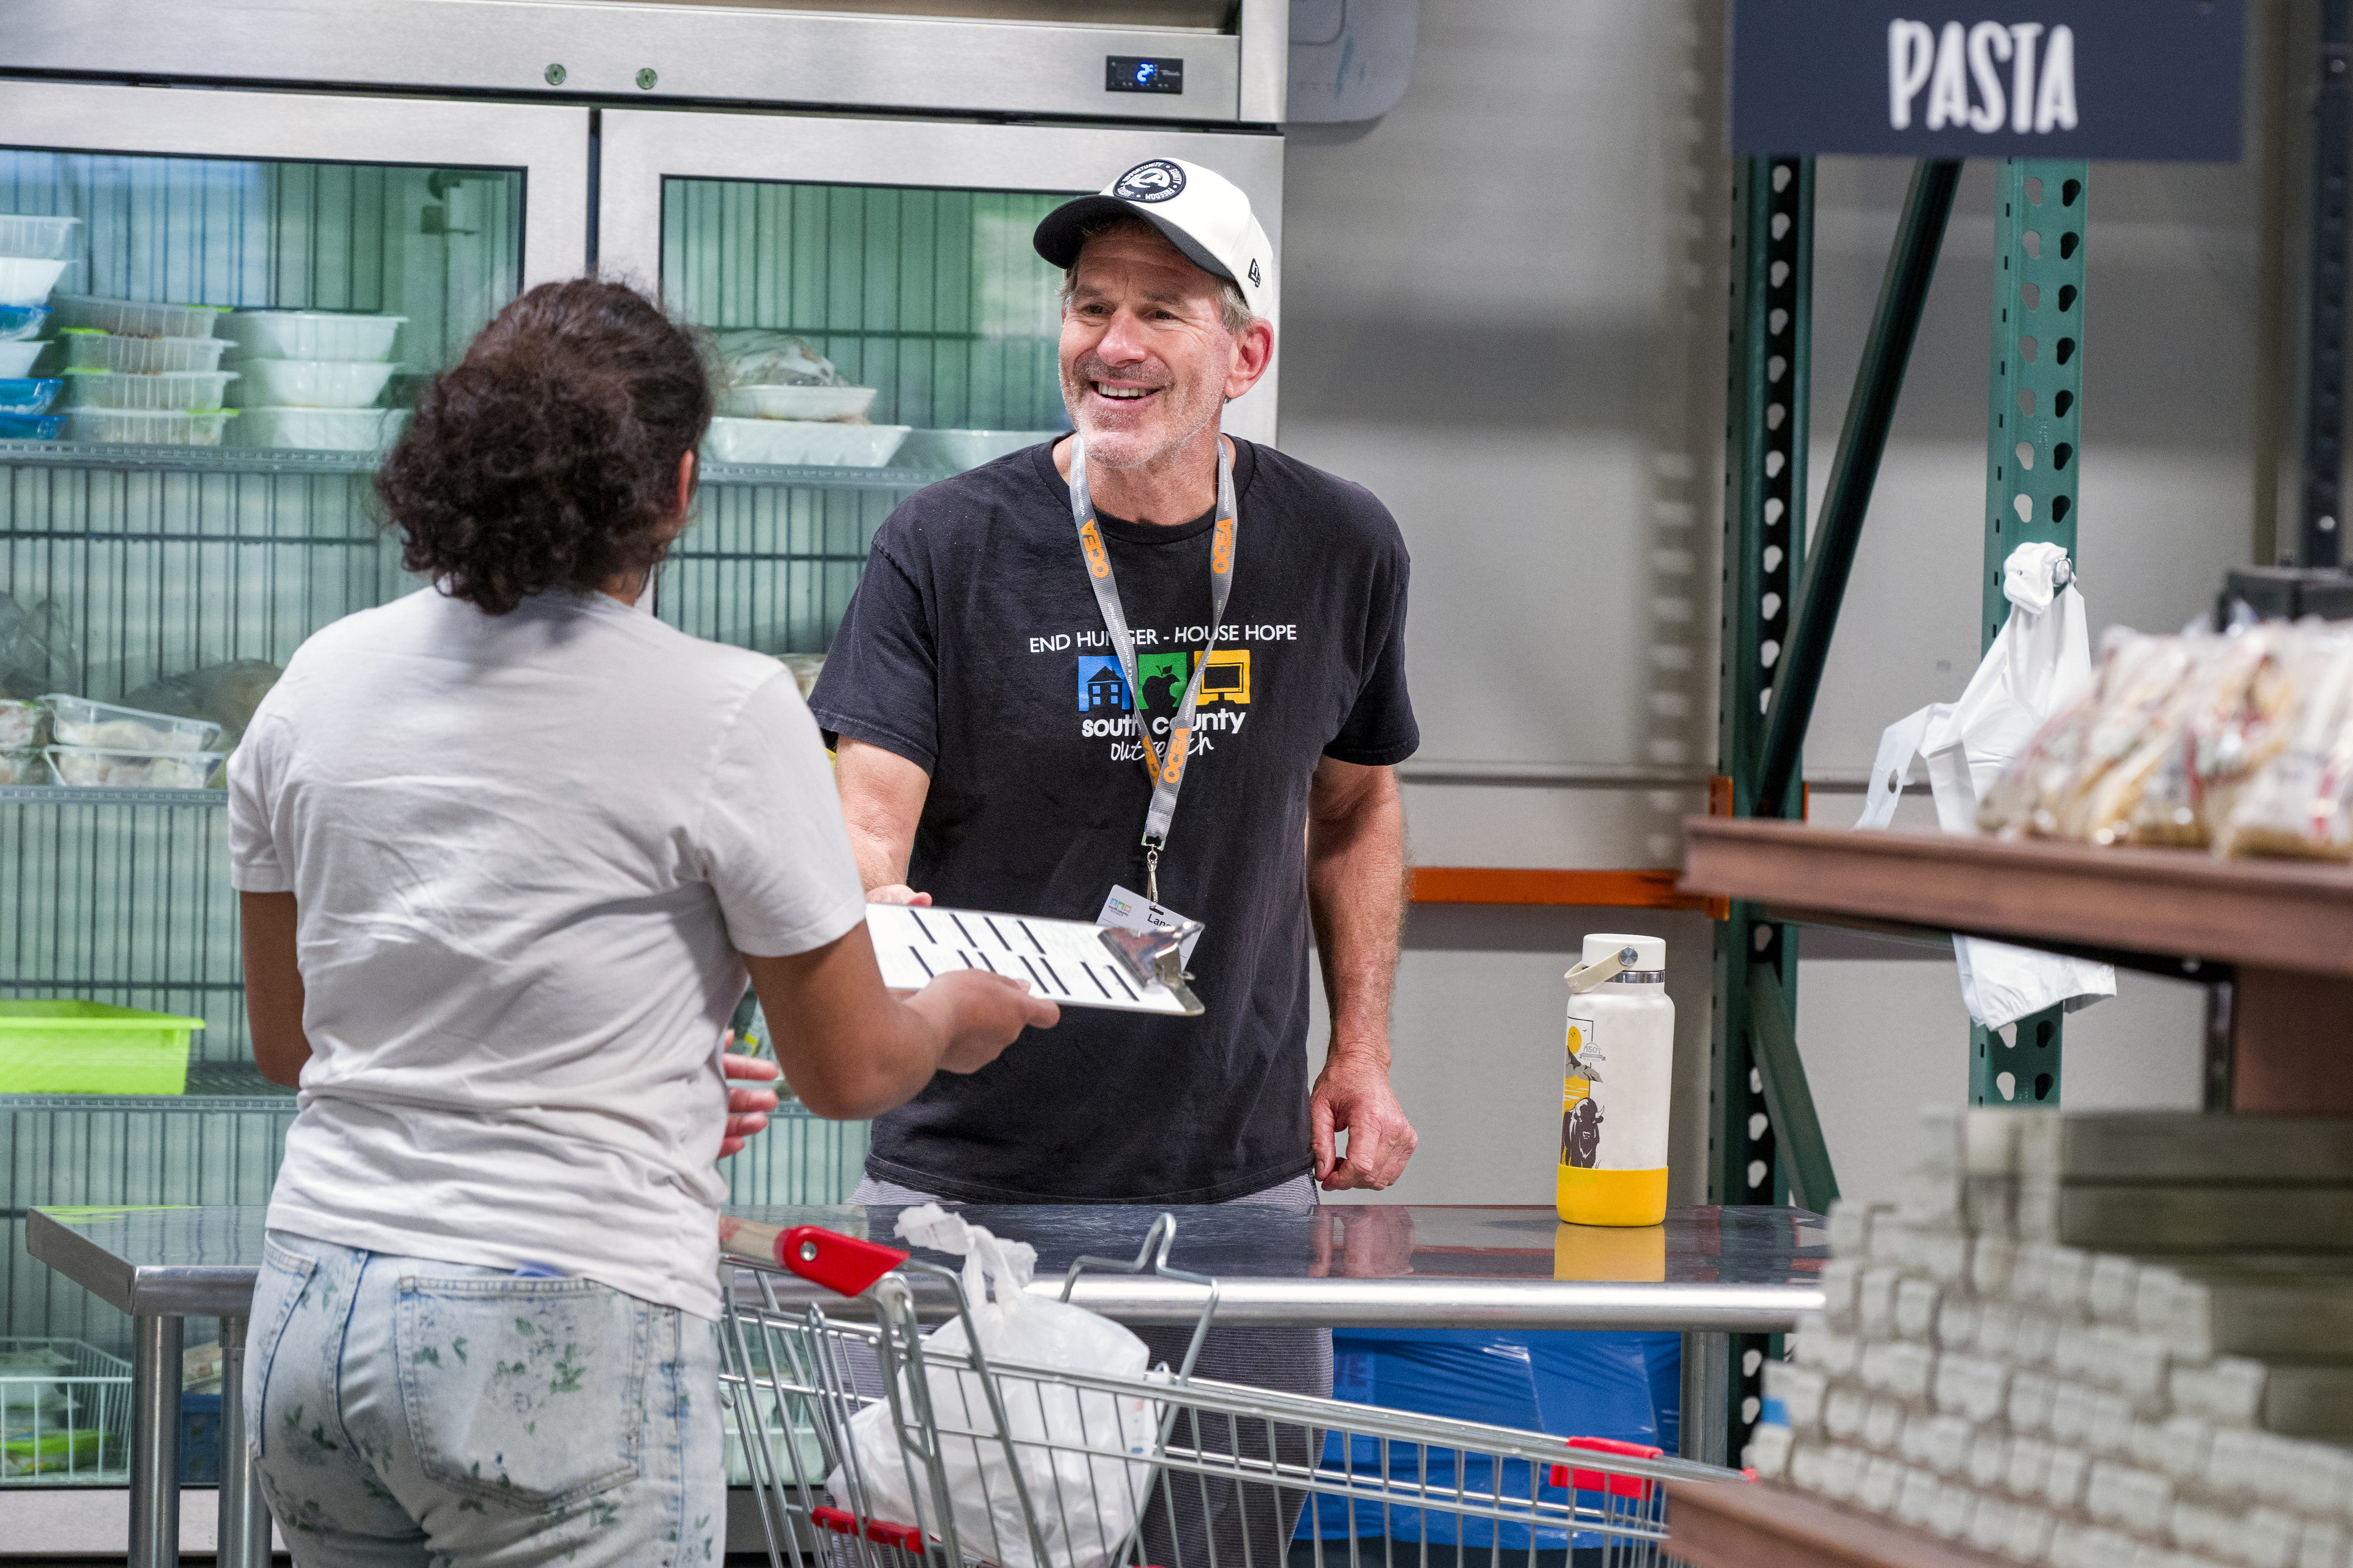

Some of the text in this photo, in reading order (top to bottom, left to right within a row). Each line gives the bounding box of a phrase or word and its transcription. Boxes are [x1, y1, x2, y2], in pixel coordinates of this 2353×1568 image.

[1888, 18, 2078, 134] PASTA
[1145, 187, 1175, 200] FREEDOM
[1076, 487, 1086, 516] WORKING
[1081, 519, 1109, 578] OCEA
[1212, 518, 1233, 574] OCEA
[1029, 634, 1071, 653] END
[1174, 625, 1239, 643] HOUSE
[1245, 624, 1297, 641] HOPE
[1108, 602, 1121, 635] TOGETHER
[1164, 728, 1190, 783] OCEA
